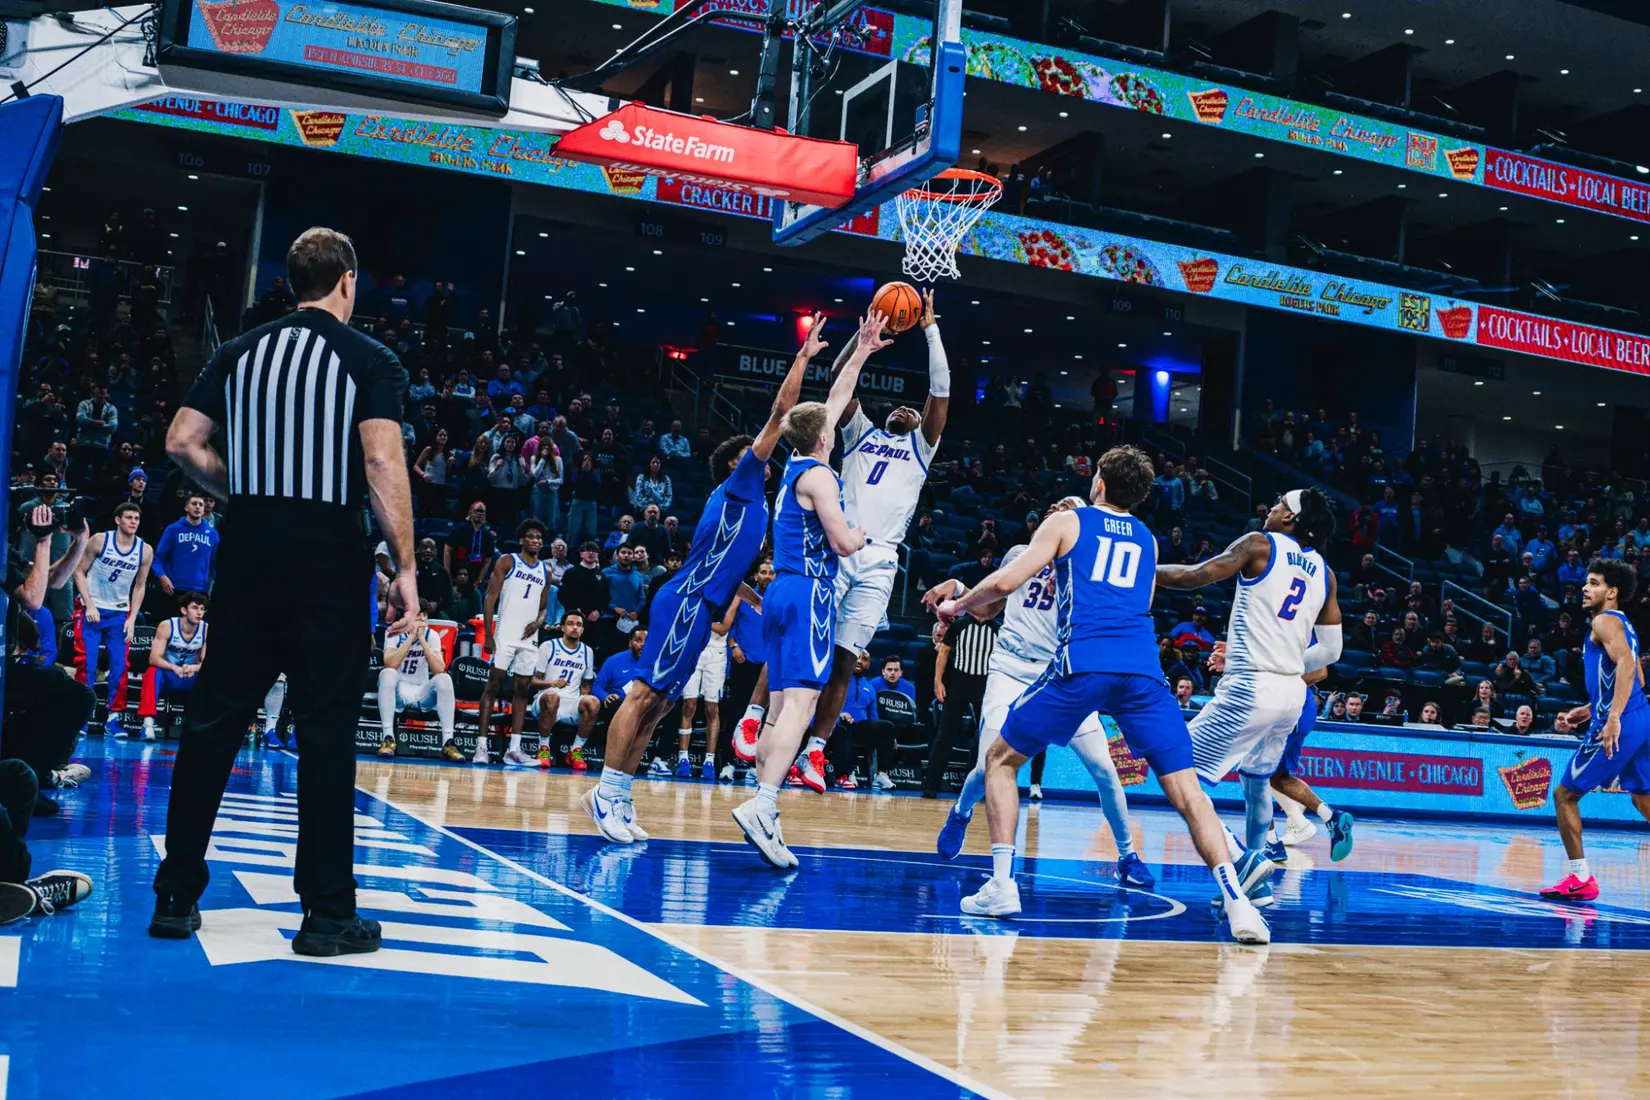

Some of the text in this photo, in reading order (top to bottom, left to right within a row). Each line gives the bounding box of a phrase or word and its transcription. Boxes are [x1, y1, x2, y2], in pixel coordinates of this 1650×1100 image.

[284, 4, 485, 57] Candlelite Chicago
[215, 100, 277, 124] CHICAGO
[355, 114, 474, 153] Candlelite
[1234, 97, 1401, 152] Candlelite Chicago
[178, 152, 205, 168] 106
[247, 162, 272, 178] 107
[1495, 155, 1568, 195] COCKTAILS
[1577, 175, 1618, 207] LOCAL
[680, 184, 753, 213] CRACKER
[640, 222, 665, 237] 108
[700, 231, 724, 246] 109
[1224, 264, 1393, 315] Candlelite Chicago
[1112, 298, 1132, 312] 109
[1164, 308, 1181, 321] 110
[1280, 294, 1340, 316] ROGERS PARK
[1488, 313, 1562, 350] COCKTAILS
[1571, 329, 1613, 360] LOCAL
[739, 353, 788, 378] BLUE
[859, 371, 905, 393] CLUB
[866, 460, 890, 486] 0
[1103, 517, 1133, 537] GREER
[1090, 535, 1143, 588] 10
[108, 568, 121, 582] 6
[523, 583, 532, 599] 1
[1023, 581, 1055, 611] 35
[1277, 576, 1308, 622] 2
[401, 659, 419, 675] 15
[466, 665, 490, 677] RUSH
[559, 669, 575, 685] 21
[885, 698, 909, 711] RUSH
[409, 733, 439, 745] RUSH
[889, 767, 916, 779] RUSH
[1348, 759, 1406, 783] AVENUE
[1417, 763, 1480, 787] CHICAGO
